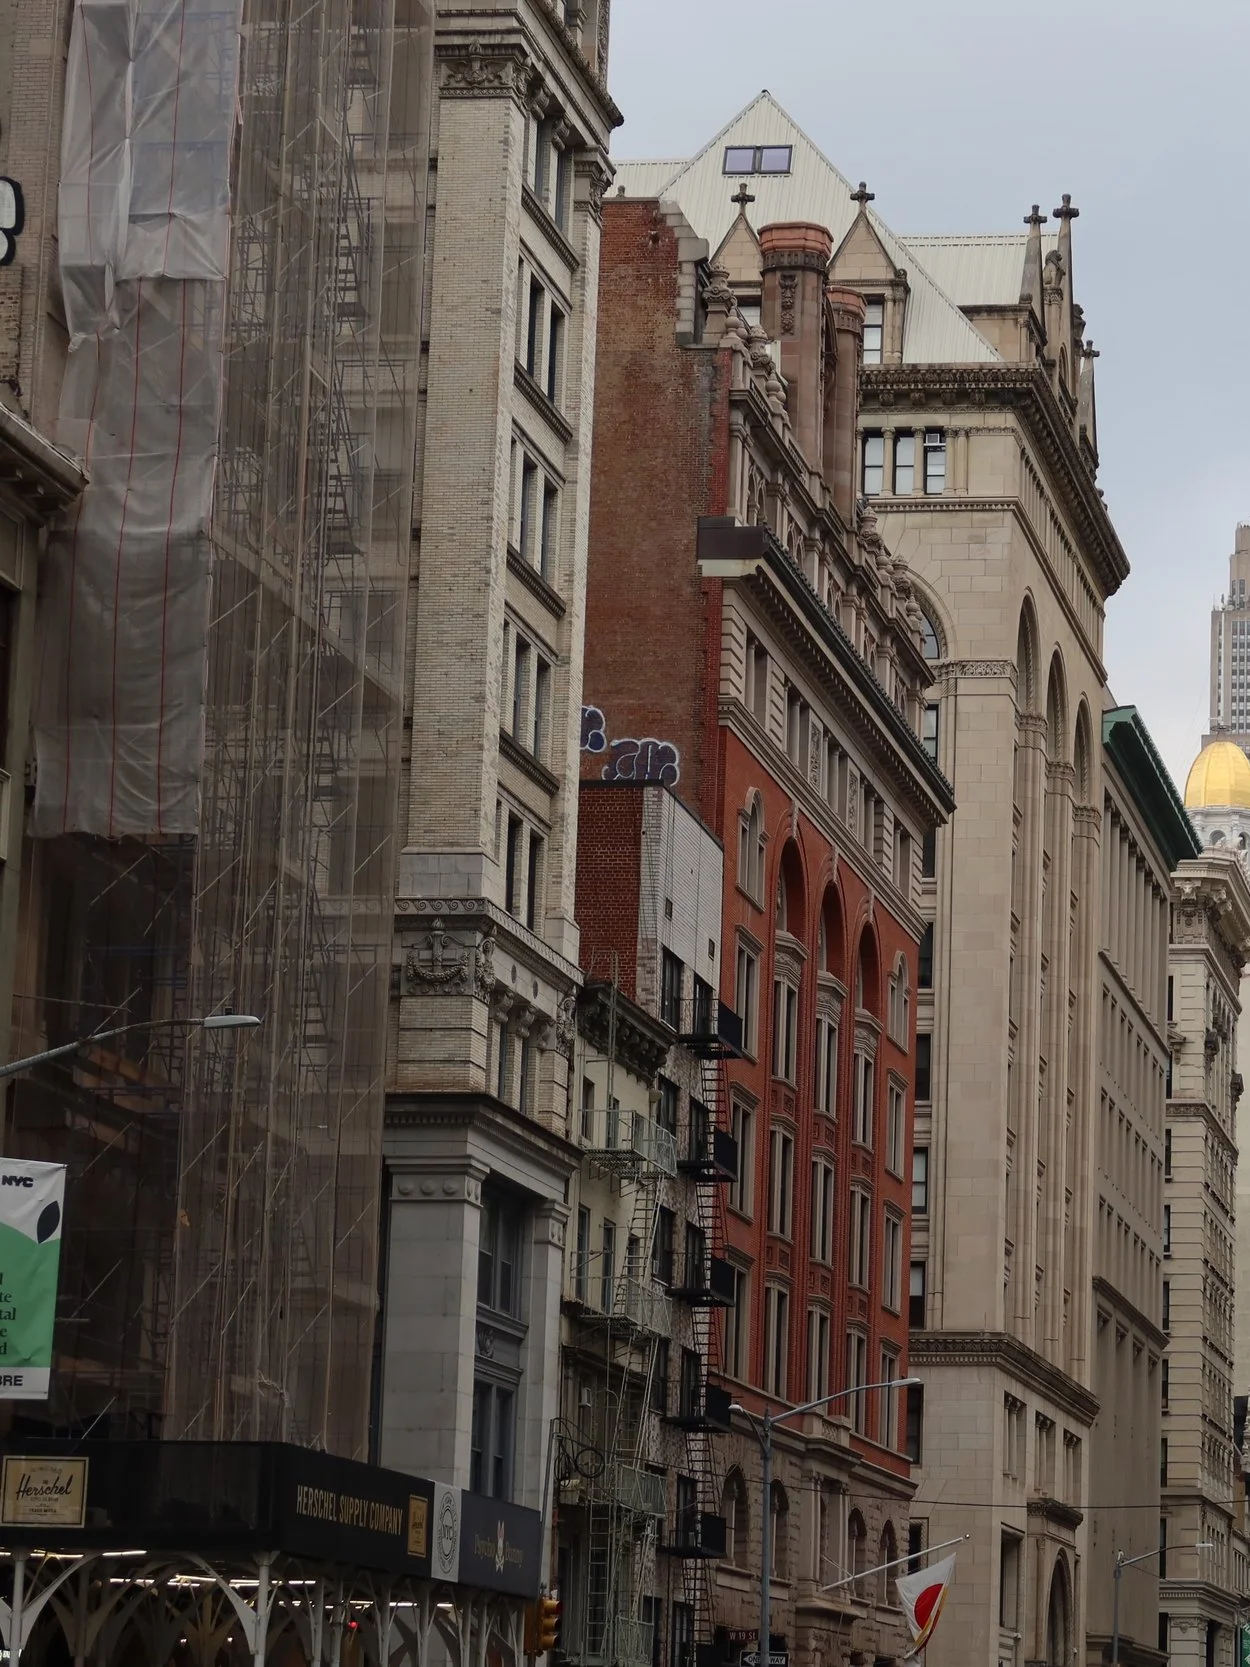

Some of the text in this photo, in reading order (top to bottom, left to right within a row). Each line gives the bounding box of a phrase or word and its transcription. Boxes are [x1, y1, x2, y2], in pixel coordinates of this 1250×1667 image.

[2, 1174, 34, 1188] NYC
[16, 1473, 74, 1500] Herschel
[296, 1484, 337, 1522] HERSCHEL
[339, 1494, 369, 1528] SUPPLY
[369, 1501, 403, 1536] COMPANY
[729, 1631, 755, 1640] W 19 St
[769, 1656, 784, 1664] WAY
